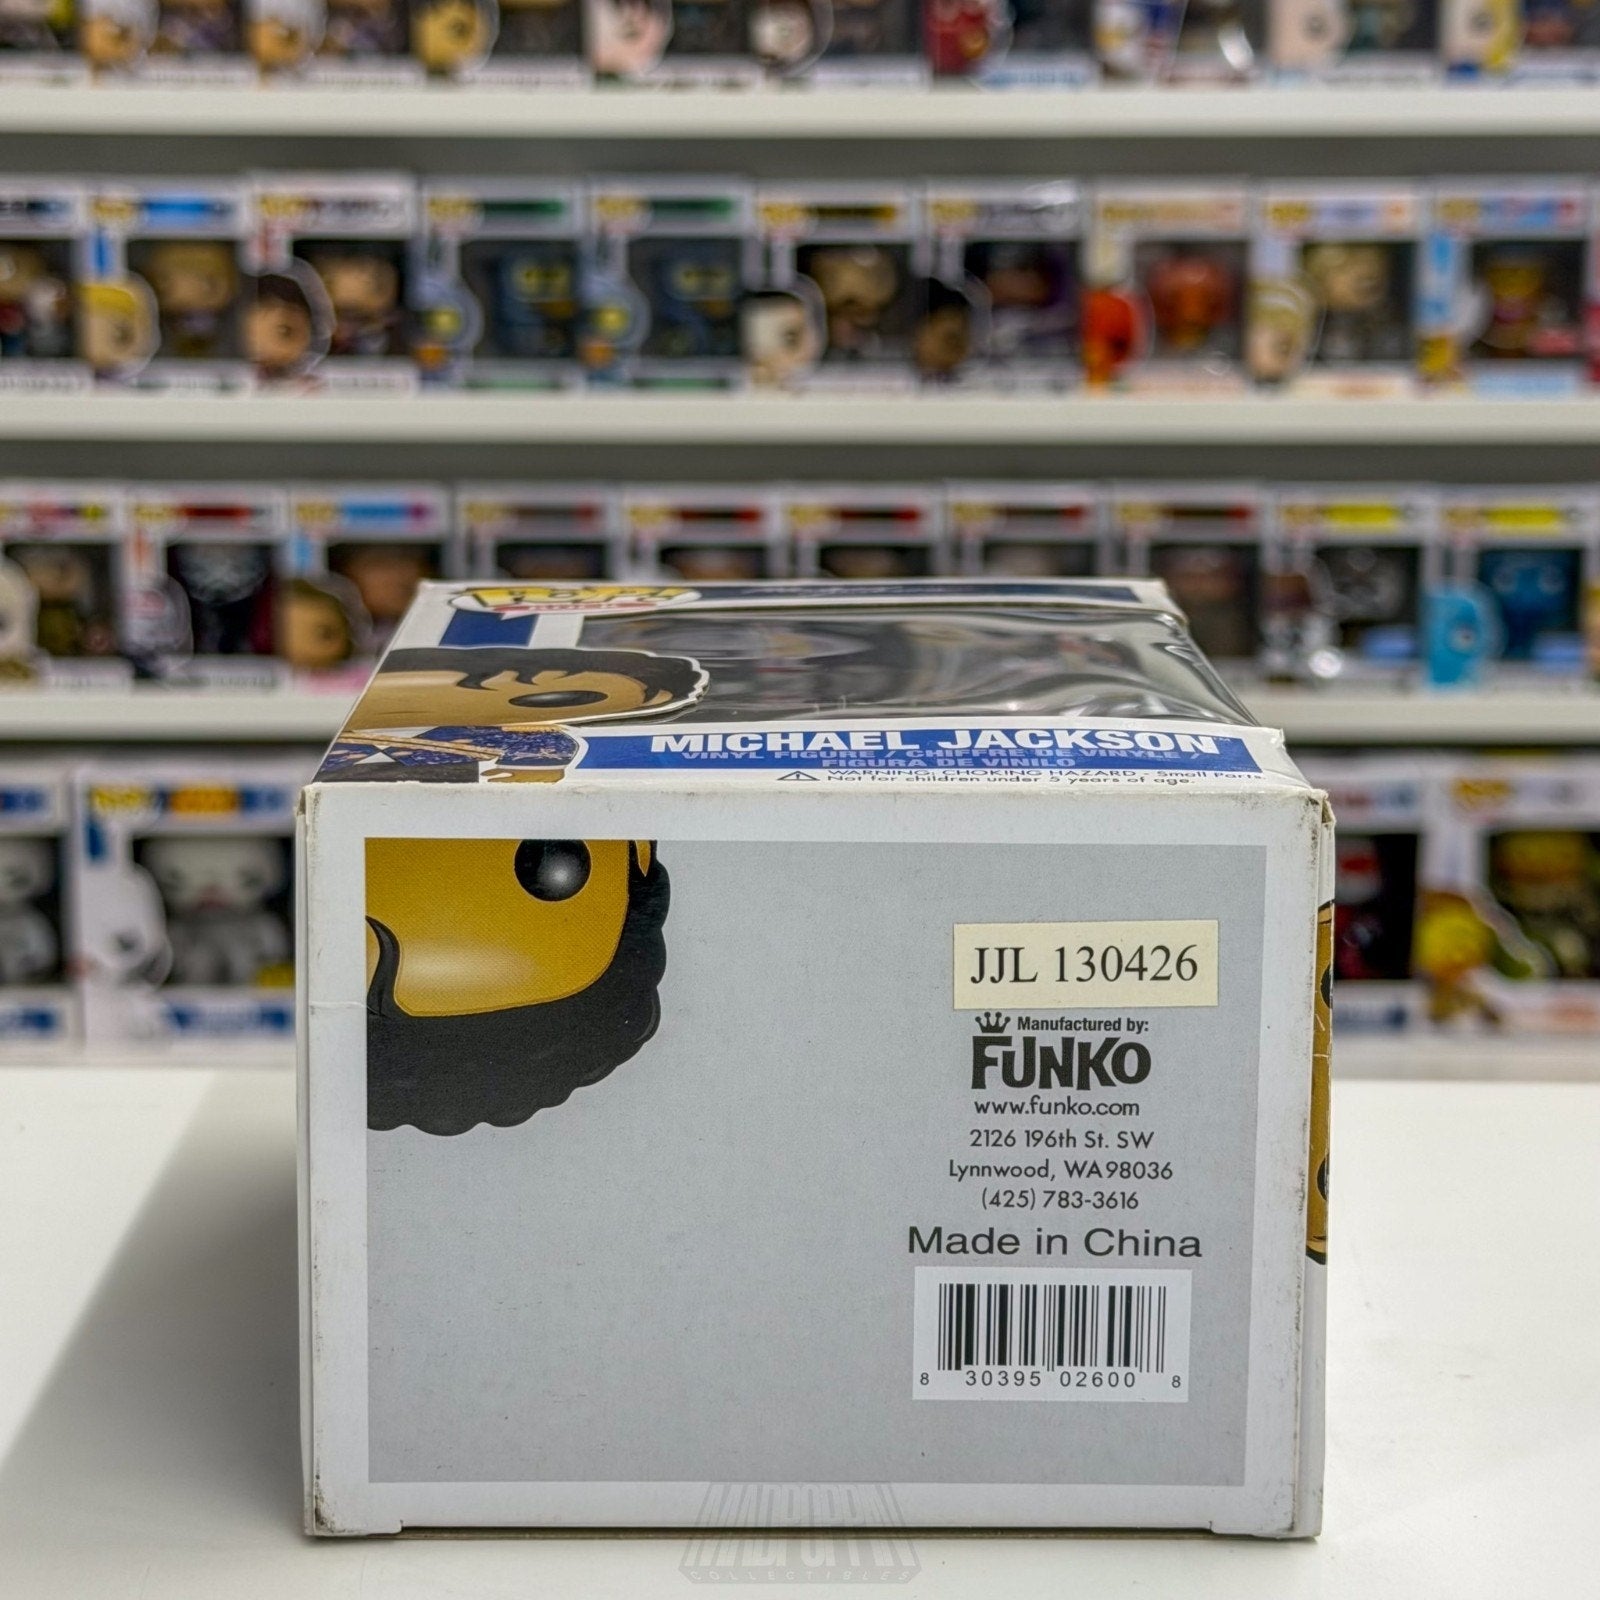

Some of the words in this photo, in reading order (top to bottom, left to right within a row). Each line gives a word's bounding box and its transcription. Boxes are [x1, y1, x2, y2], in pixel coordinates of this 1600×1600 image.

[650, 731, 920, 753] MICHAEL
[682, 751, 764, 760] VINYL
[774, 750, 875, 759] FIGURE
[905, 749, 1026, 758] CHIFFRE
[1034, 749, 1074, 757] DE
[1078, 749, 1181, 759] VINYLE
[822, 758, 927, 768] FIGURA
[936, 758, 974, 767] DE
[982, 758, 1076, 767] VINILO
[970, 946, 1039, 984] JJL
[1054, 944, 1199, 983] 130426
[1017, 1016, 1121, 1032] Manufactured
[1126, 1017, 1149, 1035] by:
[971, 1035, 1152, 1091] FUNKO
[974, 1094, 1140, 1116] www.funko.com
[969, 1129, 1017, 1147] 2126
[1024, 1129, 1077, 1149] 196th
[1084, 1130, 1109, 1149] St.
[1116, 1131, 1154, 1149] SW
[949, 1158, 1056, 1182] Lynnwood,
[981, 1187, 1036, 1211] (425)
[1043, 1190, 1139, 1209] 783-3616
[908, 1225, 1020, 1255] Made
[1036, 1227, 1068, 1256] in
[1084, 1227, 1203, 1258] China
[919, 1372, 930, 1386] 8
[965, 1370, 1042, 1387] 30395
[1060, 1371, 1136, 1387] 02600
[1170, 1374, 1182, 1389] 8
